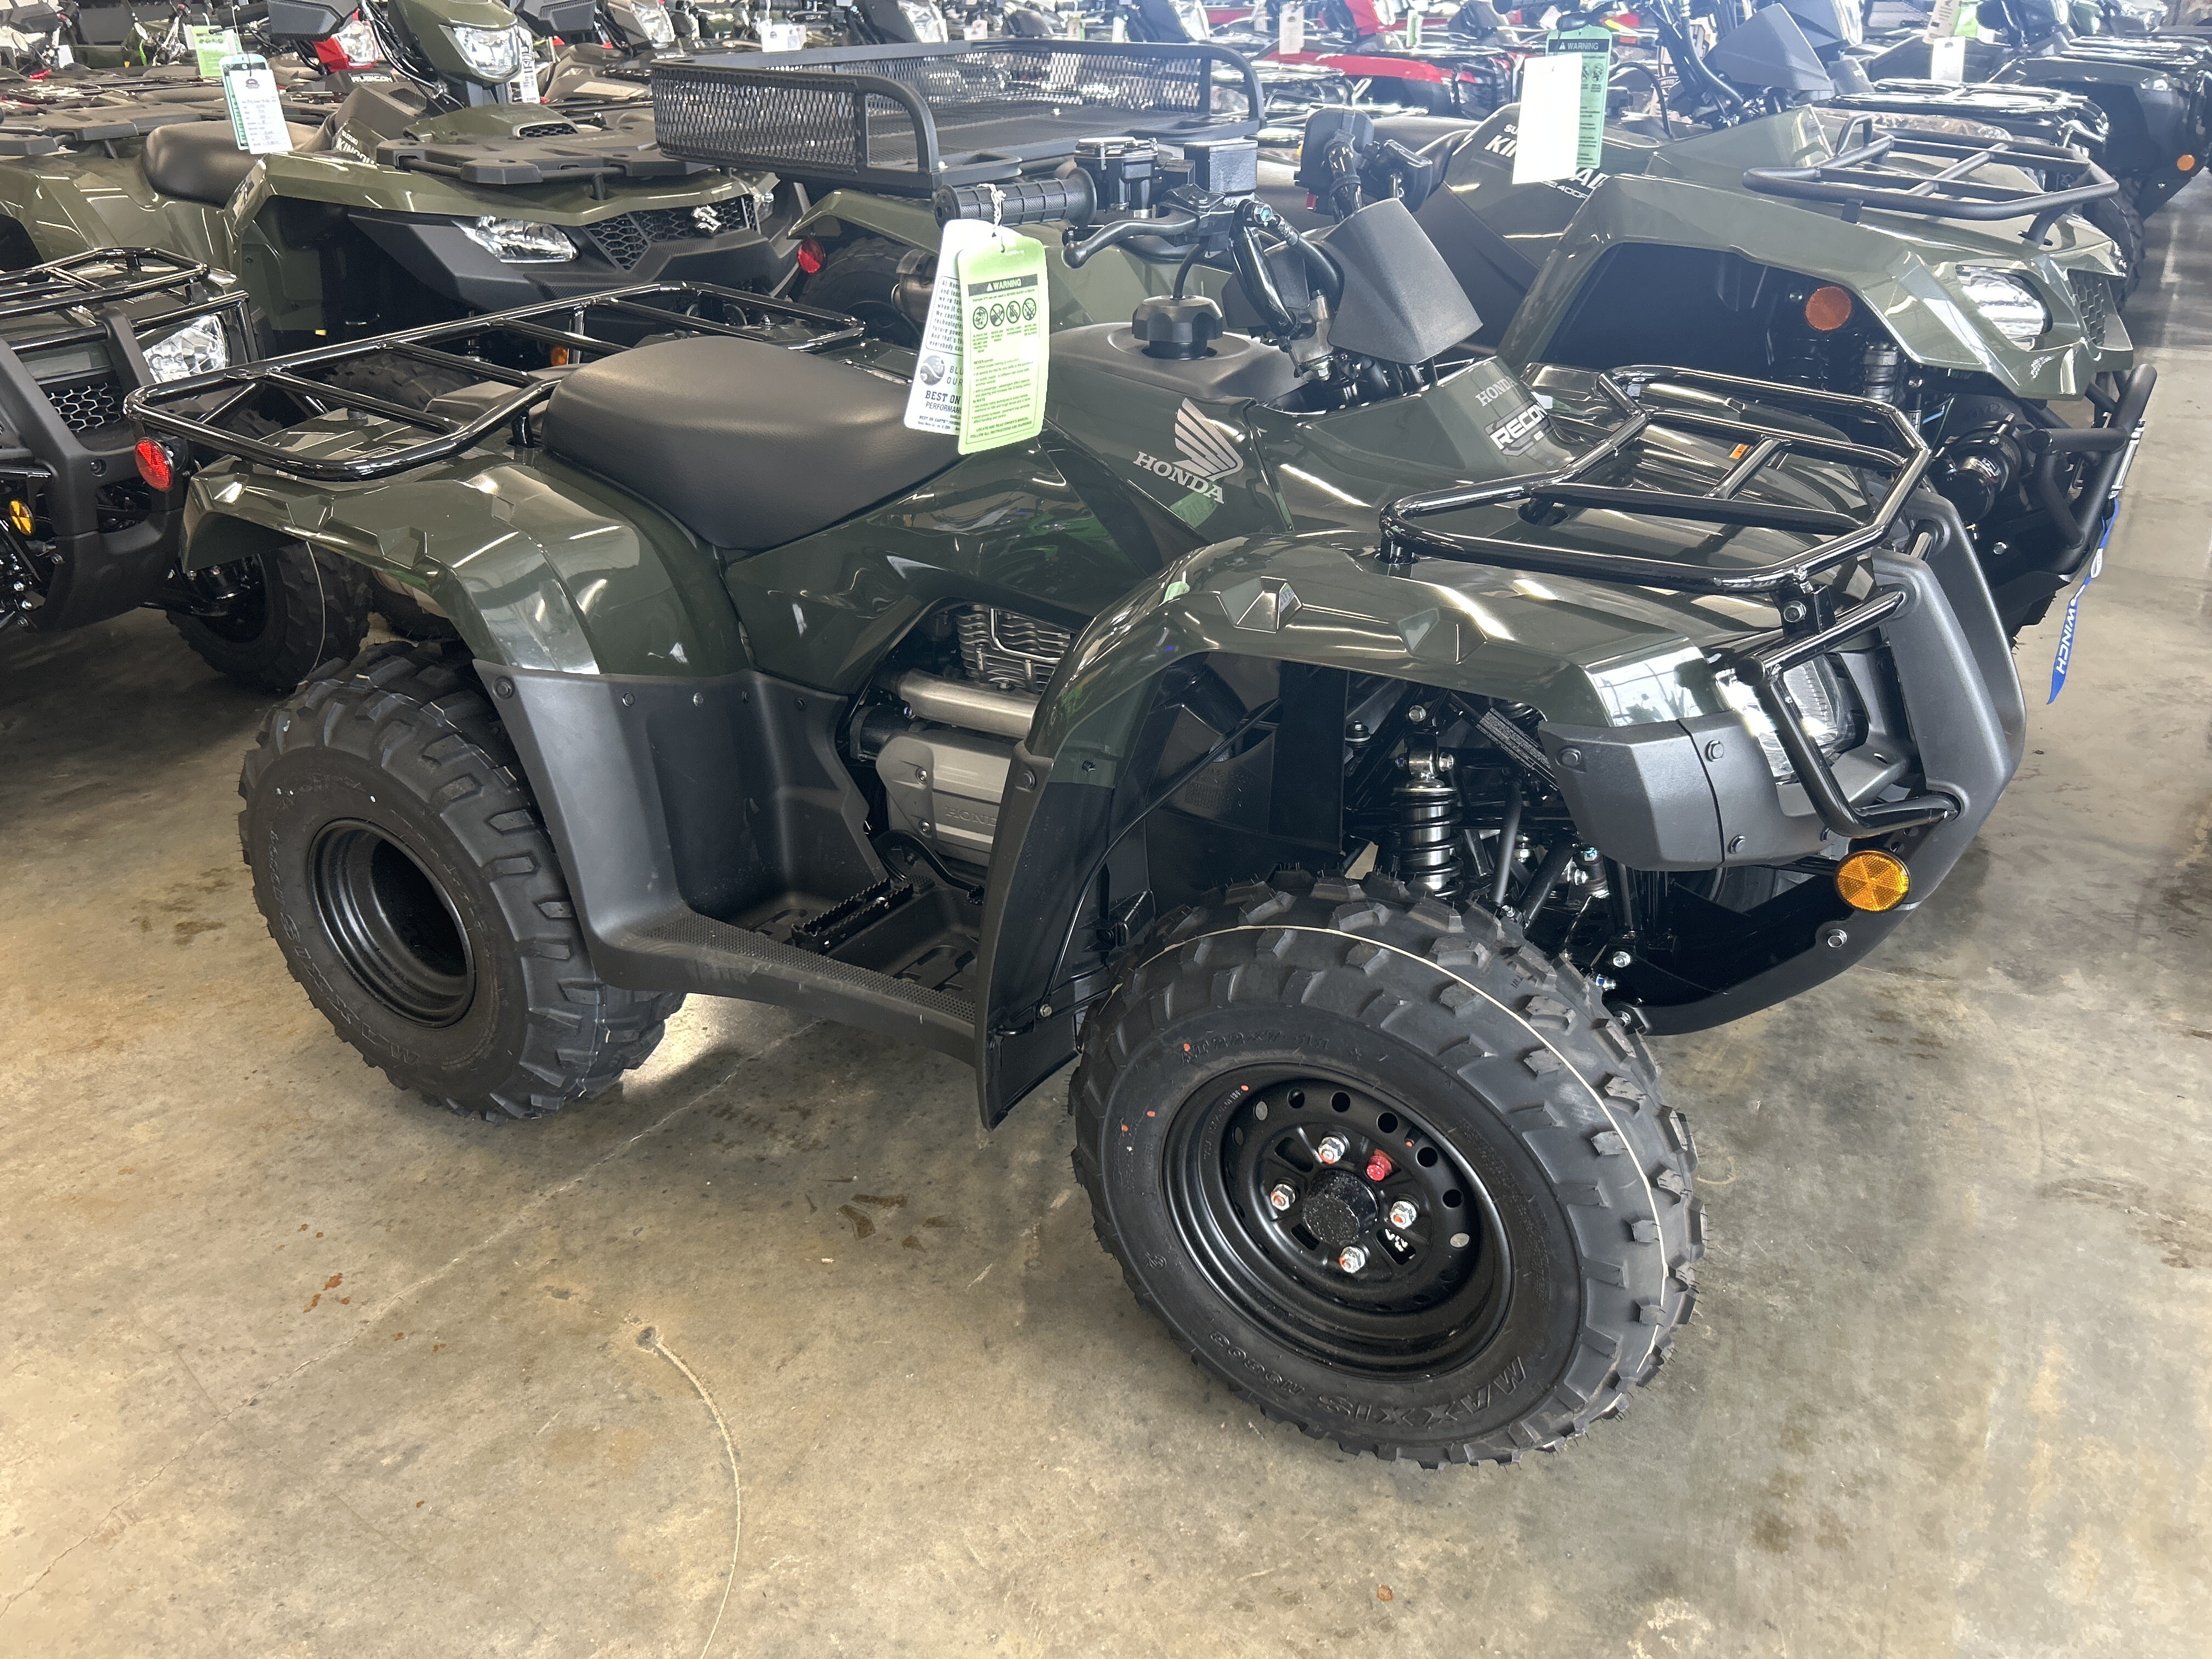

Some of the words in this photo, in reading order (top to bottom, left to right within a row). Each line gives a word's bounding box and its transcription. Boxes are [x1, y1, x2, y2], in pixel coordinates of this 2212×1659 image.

[1567, 42, 1599, 50] WARNING
[993, 278, 1022, 290] WARNING
[929, 340, 953, 351] everybody
[946, 376, 963, 386] OUR
[1475, 376, 1518, 407] HONDA
[925, 390, 948, 403] BEST
[949, 394, 961, 405] ON
[1489, 402, 1548, 450] RECON
[1133, 451, 1225, 504] HONDA
[280, 912, 421, 1065] MAXXIS
[1318, 1356, 1527, 1426] MAXXIS
